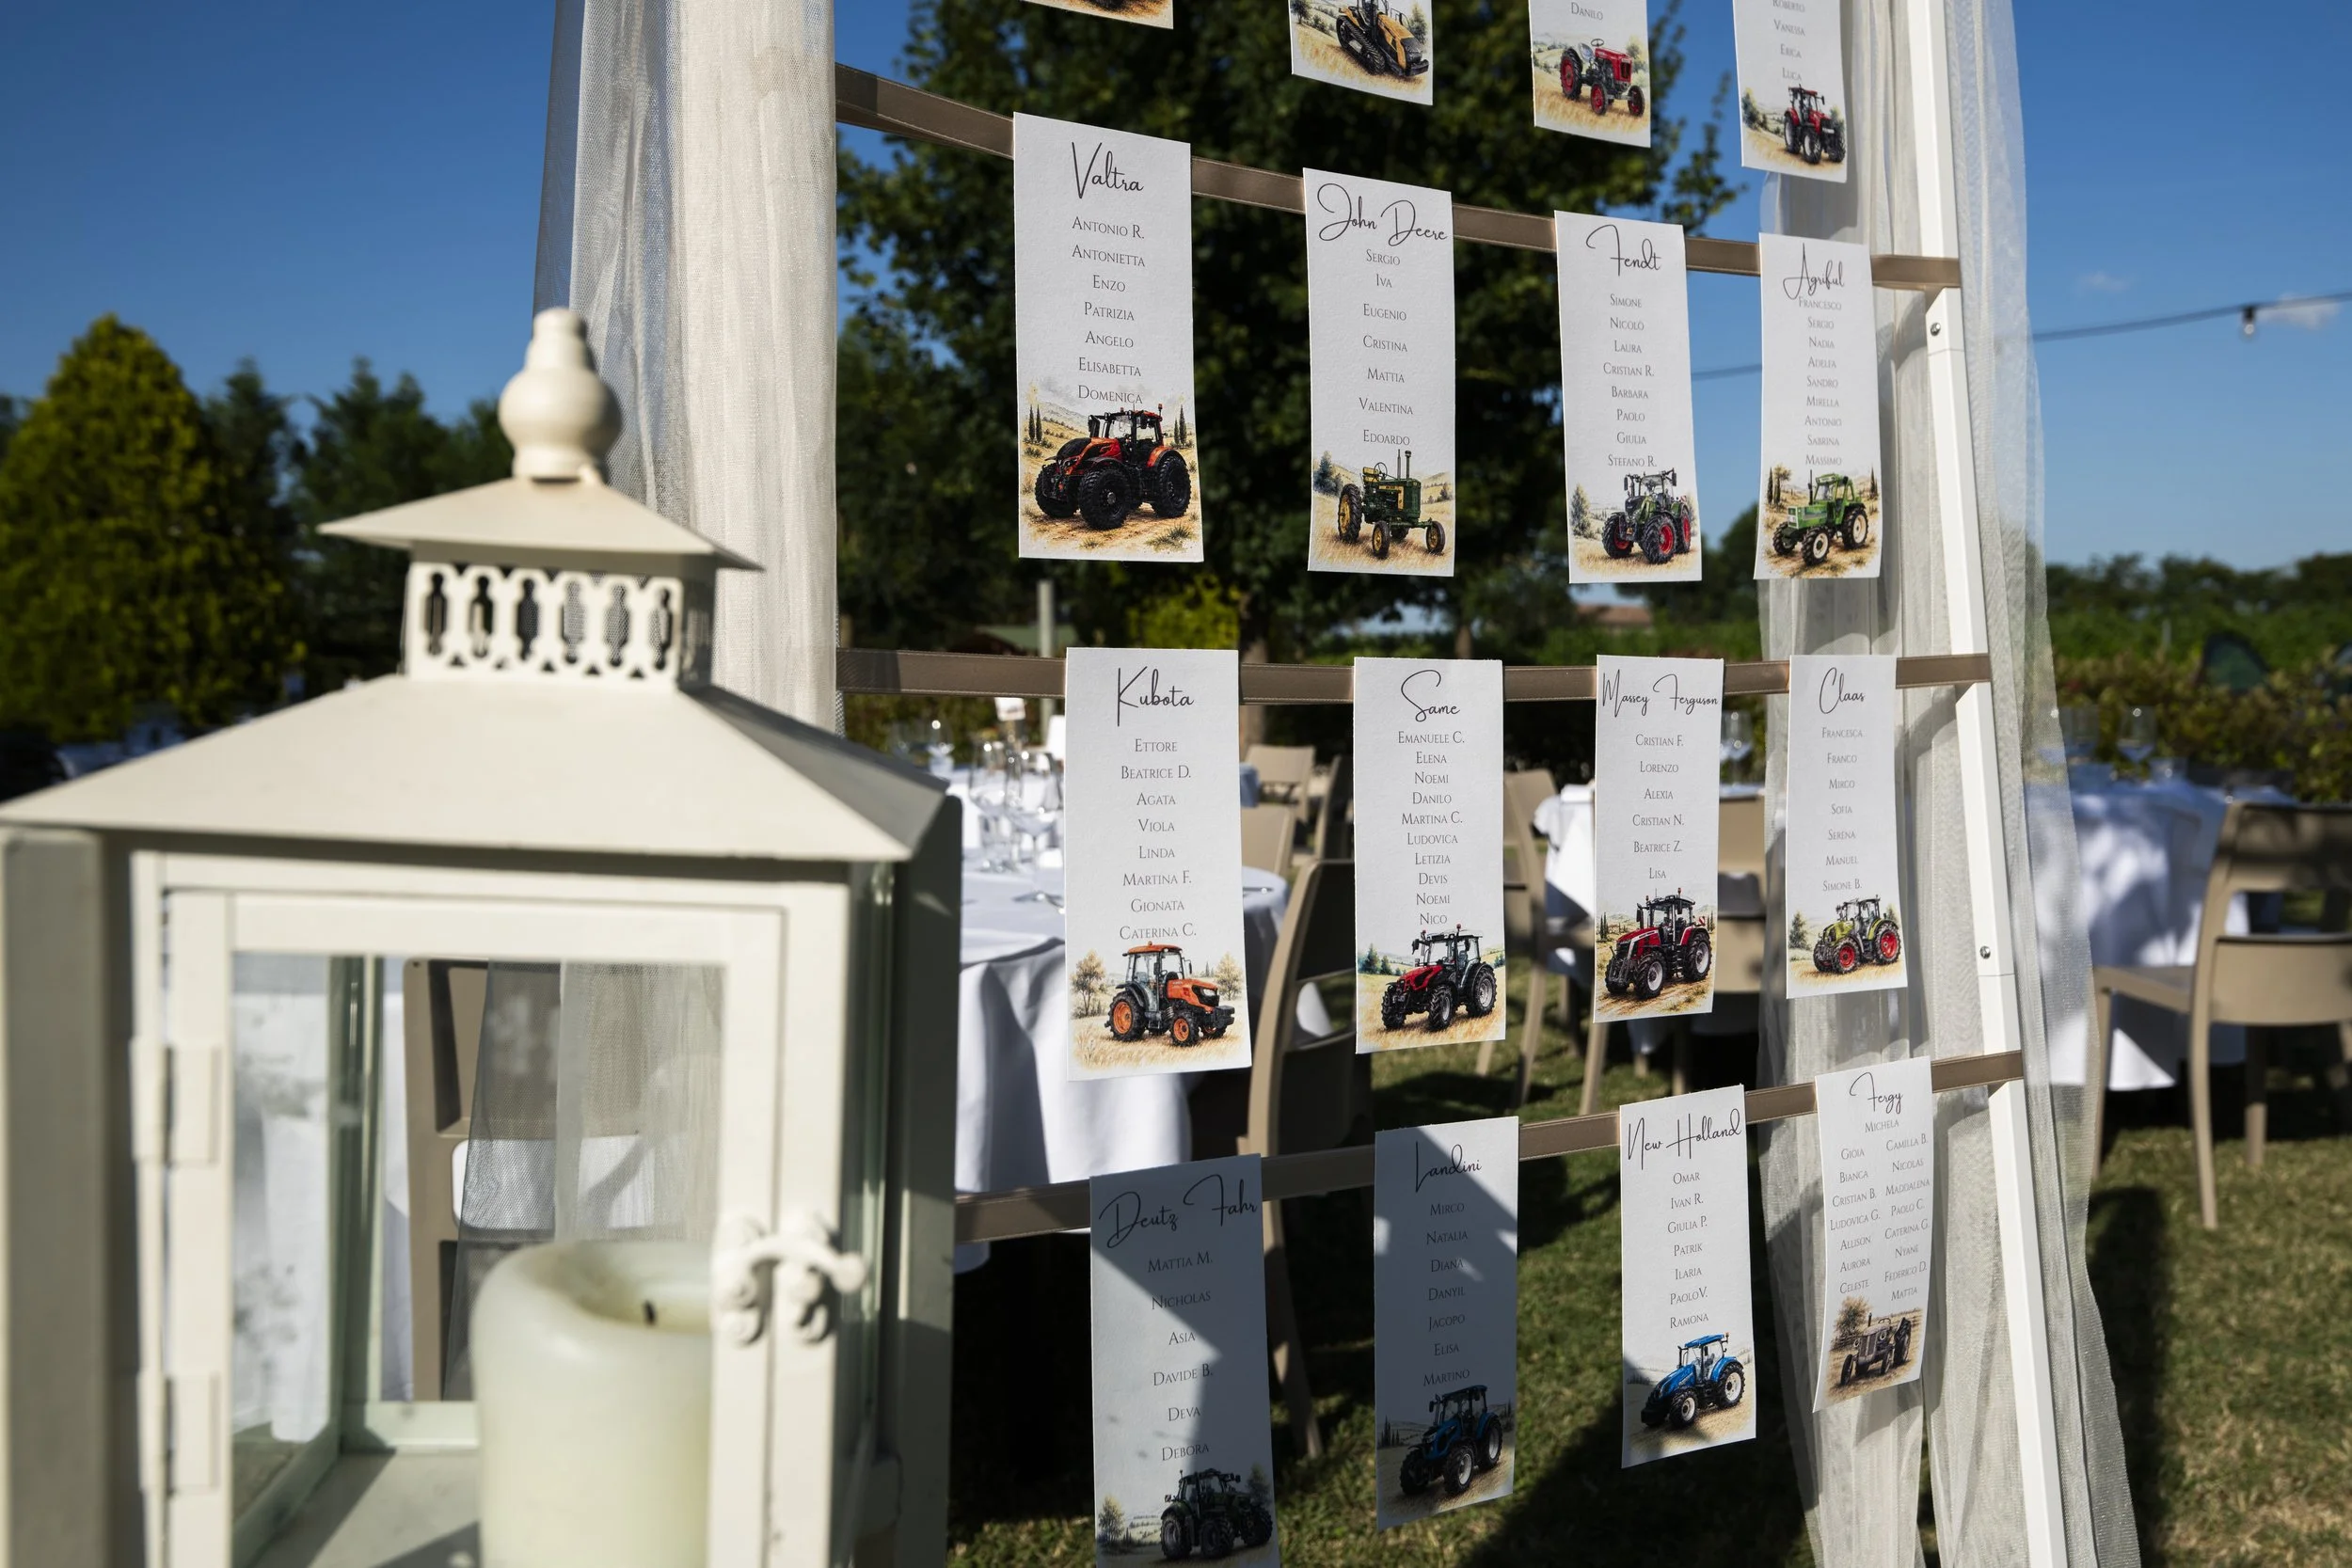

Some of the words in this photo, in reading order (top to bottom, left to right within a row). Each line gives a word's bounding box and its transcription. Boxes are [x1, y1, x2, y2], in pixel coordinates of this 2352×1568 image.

[1571, 2, 1603, 20] DANILO
[1773, 19, 1805, 36] VANESSA
[1783, 68, 1802, 81] LUCA
[1072, 142, 1144, 198] Valtra
[1317, 183, 1377, 241] John
[1380, 200, 1448, 246] Deere
[1073, 216, 1128, 236] ANTONIO
[1133, 225, 1144, 239] R.
[1073, 245, 1145, 267] ANTONIETTA
[1366, 249, 1400, 265] SERGIO
[1586, 223, 1662, 277] Fendt
[1093, 275, 1125, 292] ENZO
[1376, 274, 1391, 288] IVA
[1611, 293, 1642, 308] SIMONE
[1797, 295, 1841, 310] FRANCESCO
[1085, 302, 1134, 321] PATRIZIA
[1363, 304, 1406, 321] EUGENIO
[1808, 316, 1834, 329] SERGIO
[1085, 331, 1134, 348] ANGELO
[1363, 335, 1407, 352] CRISTINA
[1614, 340, 1642, 353] LAURA
[1809, 336, 1835, 348] NADIA
[1079, 357, 1141, 376] ELISABETTA
[1603, 362, 1642, 375] CRISTIAN
[1645, 365, 1654, 376] R.
[1368, 368, 1405, 383] MATTIA
[1807, 375, 1838, 388] SANDRO
[1078, 385, 1142, 405] DOMENICA
[1612, 386, 1648, 399] BARBARA
[1359, 397, 1413, 414] VALENTINA
[1806, 395, 1839, 407] MIRELLA
[1617, 408, 1645, 421] PAOLO
[1804, 415, 1842, 426] ANTONIO
[1364, 430, 1409, 445] EDOARDO
[1617, 432, 1646, 444] GIULIA
[1807, 435, 1839, 446] SABRINA
[1608, 453, 1645, 467] STEFANO
[1648, 455, 1657, 467] R.
[1805, 454, 1842, 466] MASSIMO
[1118, 666, 1194, 727] Kubota
[1401, 670, 1460, 722] Same
[1603, 669, 1649, 718] Massey
[1653, 673, 1718, 715] Ferguson
[1820, 667, 1865, 714] Claas
[1399, 731, 1449, 743] EMANUELE
[1453, 731, 1464, 743] C.
[1822, 727, 1864, 738] FRANCESCA
[1136, 738, 1177, 752] ETTORE
[1636, 734, 1674, 746] CRISTIAN
[1677, 735, 1683, 746] F.
[1416, 752, 1447, 764] ELENA
[1827, 752, 1857, 764] FRANCO
[1121, 766, 1173, 779] BEATRICE
[1179, 765, 1191, 778] D.
[1641, 761, 1678, 772] LORENZO
[1415, 771, 1448, 784] NOEMI
[1829, 779, 1855, 789] MIRCO
[1136, 793, 1175, 805] AGATA
[1413, 792, 1452, 804] DANILO
[1645, 788, 1673, 800] ALEXIA
[1832, 803, 1852, 815] SOFIA
[1402, 813, 1447, 824] MARTINA
[1451, 811, 1462, 823] C.
[1632, 815, 1670, 826] CRISTIAN
[1674, 814, 1684, 825] N.
[1138, 818, 1174, 832] VIOLA
[1407, 832, 1458, 845] LUDOVICA
[1828, 829, 1856, 840] SERENA
[1139, 846, 1175, 859] LINDA
[1634, 841, 1670, 852] BEATRICE
[1674, 841, 1682, 851] Z.
[1415, 852, 1450, 864] LETIZIA
[1826, 855, 1857, 865] MANUEL
[1123, 873, 1178, 886] MARTINA
[1184, 870, 1191, 883] F.
[1419, 873, 1447, 884] DEVIS
[1649, 867, 1666, 879] LISA
[1823, 880, 1851, 892] SIMONE
[1855, 879, 1862, 889] B.
[1131, 898, 1184, 912] GIONATA
[1417, 893, 1450, 905] NOEMI
[1421, 912, 1447, 925] NICO
[1120, 926, 1178, 941] CATERINA
[1183, 923, 1196, 936] C.
[1850, 1072, 1903, 1115] Fergy
[1866, 1119, 1899, 1132] MICHELA
[1629, 1117, 1663, 1170] New
[1666, 1108, 1741, 1159] Holland
[1886, 1138, 1918, 1151] CAMILLA
[1921, 1133, 1928, 1144] B.
[1841, 1148, 1865, 1160] GIOIA
[1416, 1141, 1482, 1193] Landini
[1893, 1158, 1923, 1172] NICOLAS
[1674, 1172, 1700, 1184] OMAR
[1840, 1171, 1868, 1183] BIANCA
[1885, 1180, 1930, 1196] MADDALENA
[1671, 1197, 1691, 1209] IVAN
[1694, 1194, 1703, 1204] R.
[1833, 1193, 1867, 1207] CRISTIAN
[1869, 1188, 1876, 1199] B.
[1099, 1192, 1178, 1248] Deutz
[1183, 1174, 1257, 1227] Fahr
[1430, 1203, 1464, 1215] MIRCO
[1891, 1204, 1915, 1216] PAOLO
[1916, 1198, 1925, 1210] C.
[1668, 1221, 1697, 1233] GIULIA
[1701, 1216, 1707, 1227] P.
[1830, 1215, 1868, 1230] LUDOVICA
[1426, 1230, 1468, 1245] NATALIA
[1885, 1224, 1919, 1239] CATERINA
[1675, 1243, 1702, 1256] PATRIK
[1840, 1235, 1870, 1250] ALLISON
[1148, 1258, 1193, 1273] MATTIA
[1197, 1251, 1213, 1265] M.
[1431, 1259, 1463, 1272] DIANA
[1840, 1259, 1870, 1273] AURORA
[1676, 1268, 1702, 1279] ILARIA
[1884, 1266, 1917, 1282] FEDERICO
[1919, 1261, 1927, 1272] D.
[1840, 1279, 1869, 1293] CELESTE
[1152, 1291, 1211, 1309] NICHOLAS
[1429, 1287, 1465, 1301] DANYIL
[1891, 1287, 1917, 1301] MATTIA
[1429, 1314, 1465, 1332] JACOPO
[1671, 1314, 1708, 1328] RAMONA
[1168, 1332, 1195, 1345] ASIA
[1435, 1343, 1459, 1355] ELISA
[1153, 1369, 1197, 1386] DAVIDE
[1202, 1363, 1212, 1377] B.
[1423, 1370, 1471, 1387] MARTINO
[1168, 1407, 1200, 1421] DEVA
[1163, 1445, 1209, 1461] DEBORA
